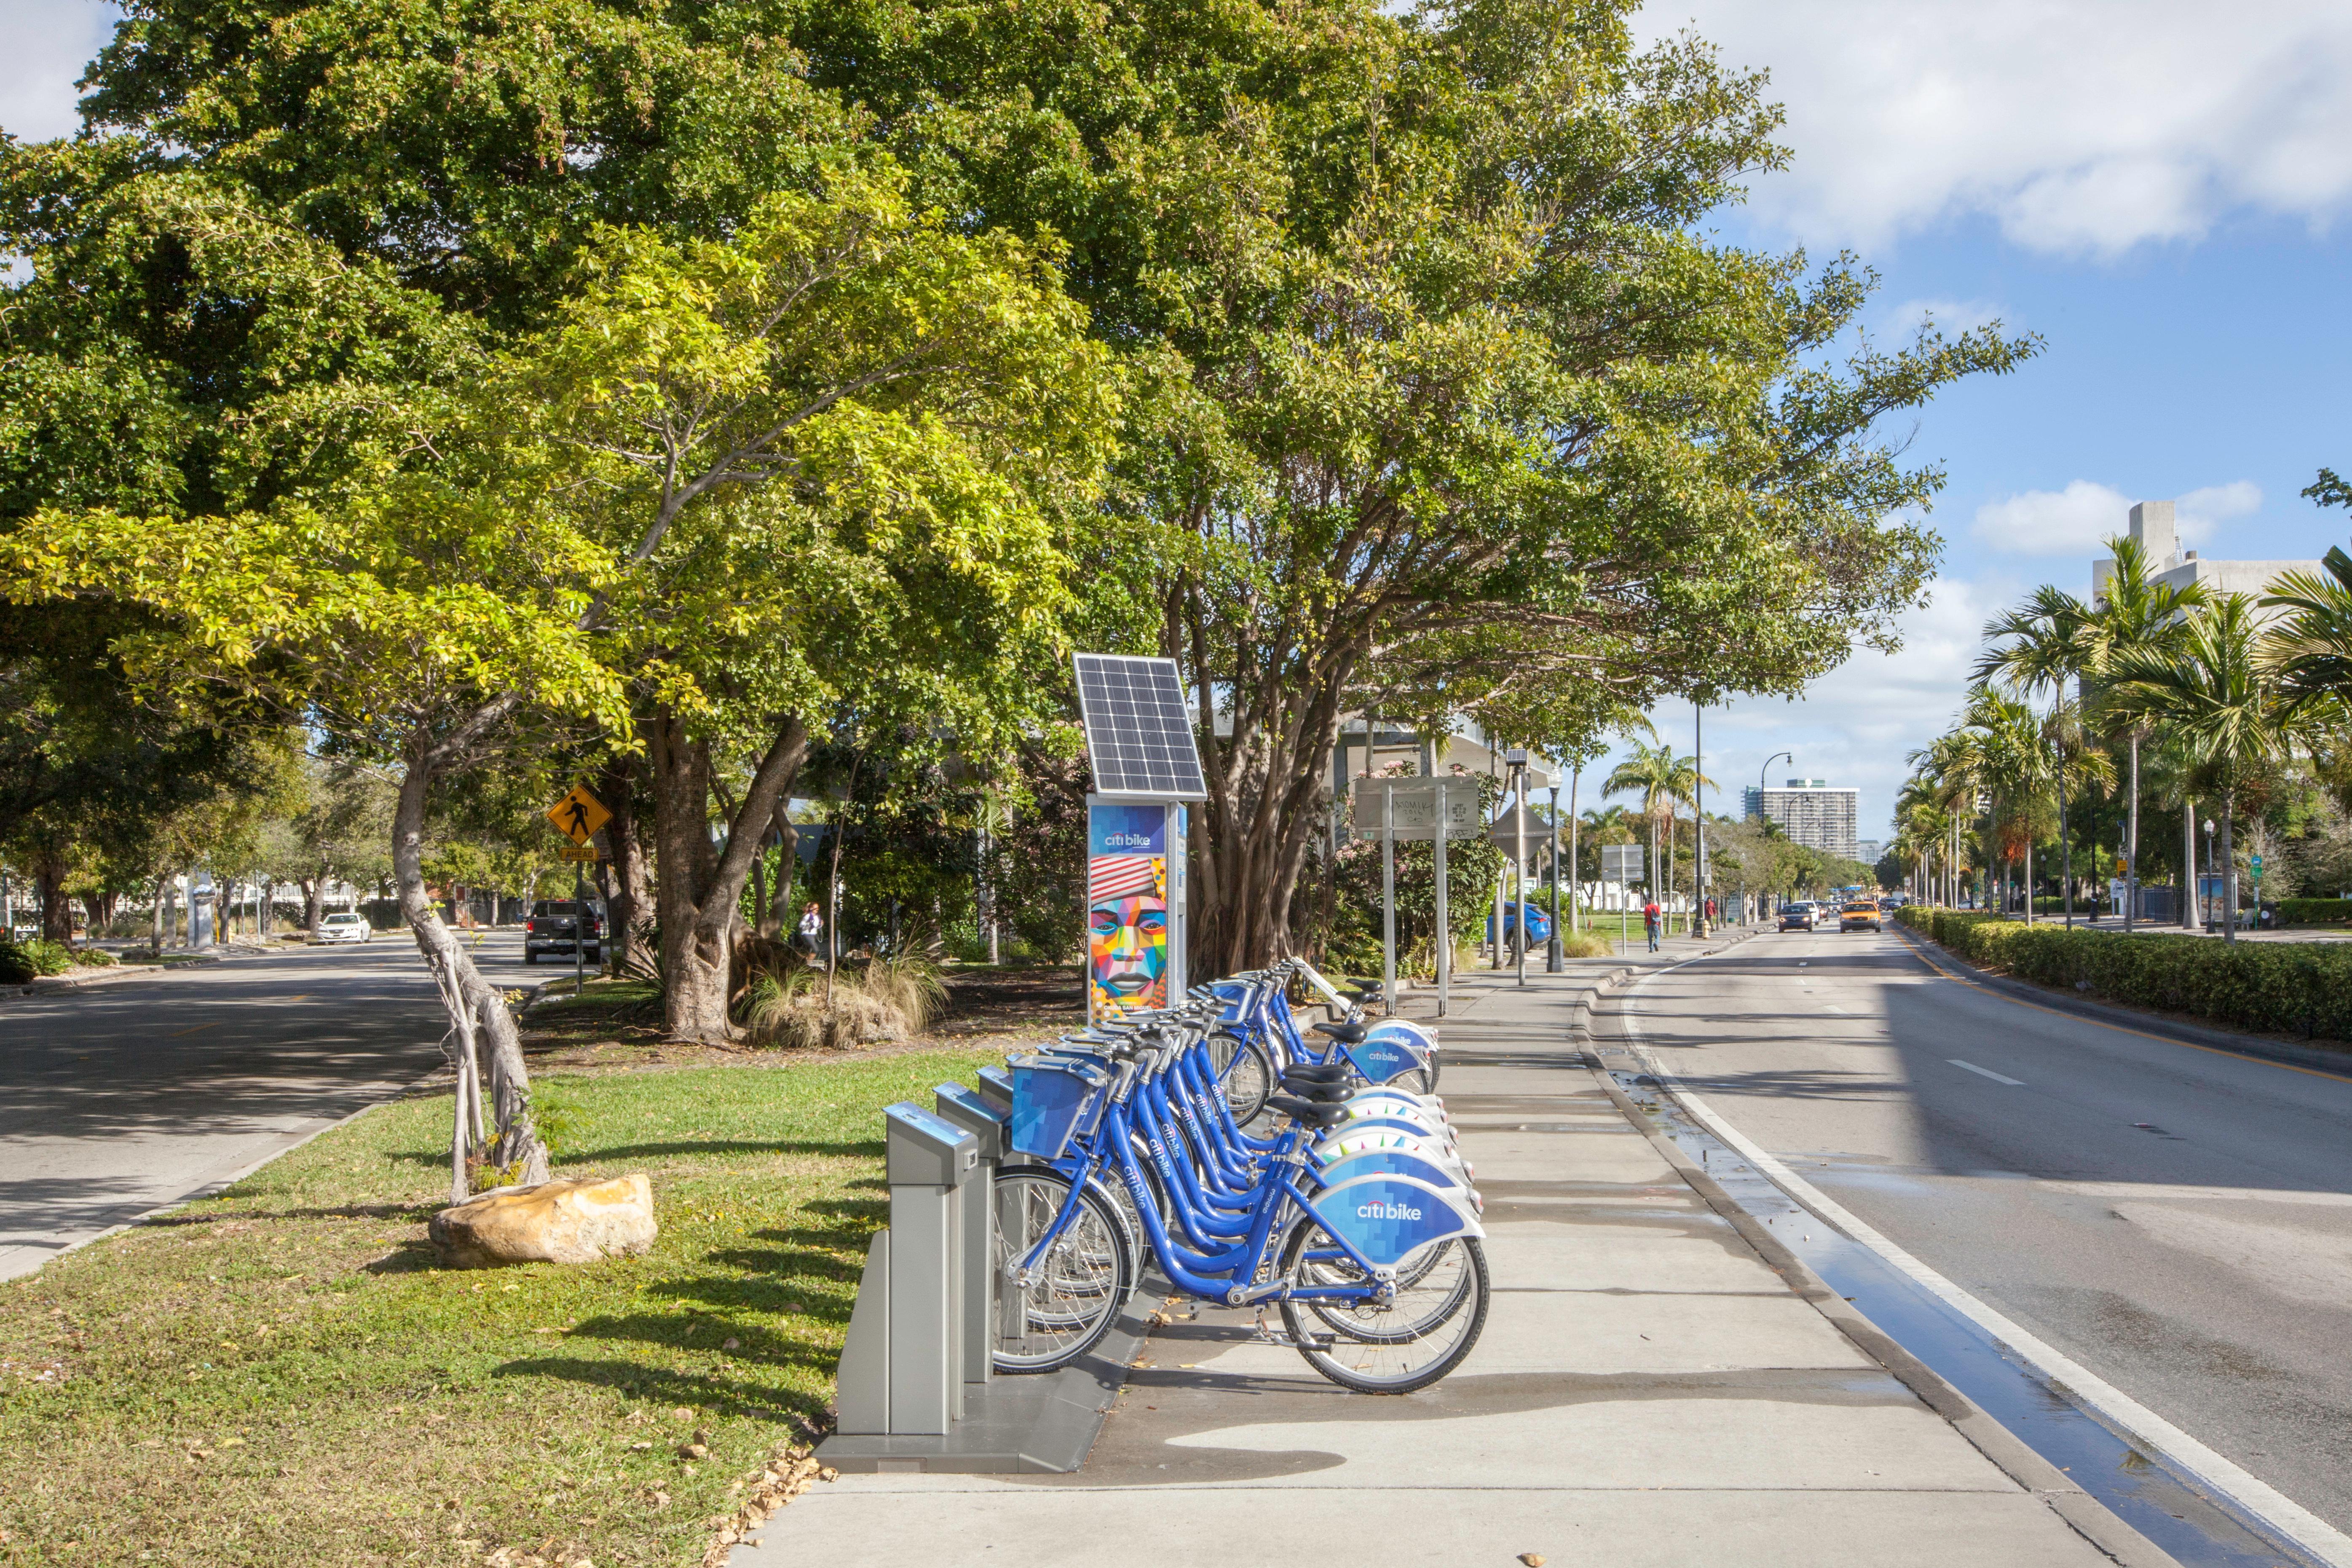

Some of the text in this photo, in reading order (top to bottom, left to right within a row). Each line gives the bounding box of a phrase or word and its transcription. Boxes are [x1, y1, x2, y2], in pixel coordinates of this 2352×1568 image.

[1105, 833, 1150, 846] citi bike
[1396, 1036, 1411, 1044] bike
[1369, 1051, 1399, 1061] citi bike
[1196, 1094, 1212, 1125] citi bike
[1211, 1084, 1227, 1113] citi bike
[1180, 1107, 1198, 1139] citi bike
[1162, 1123, 1180, 1158] citi bike
[1149, 1139, 1171, 1177] citi bike
[1124, 1166, 1146, 1209] citi bike
[1262, 1188, 1276, 1214] 3366
[1357, 1201, 1422, 1220] citi bike
